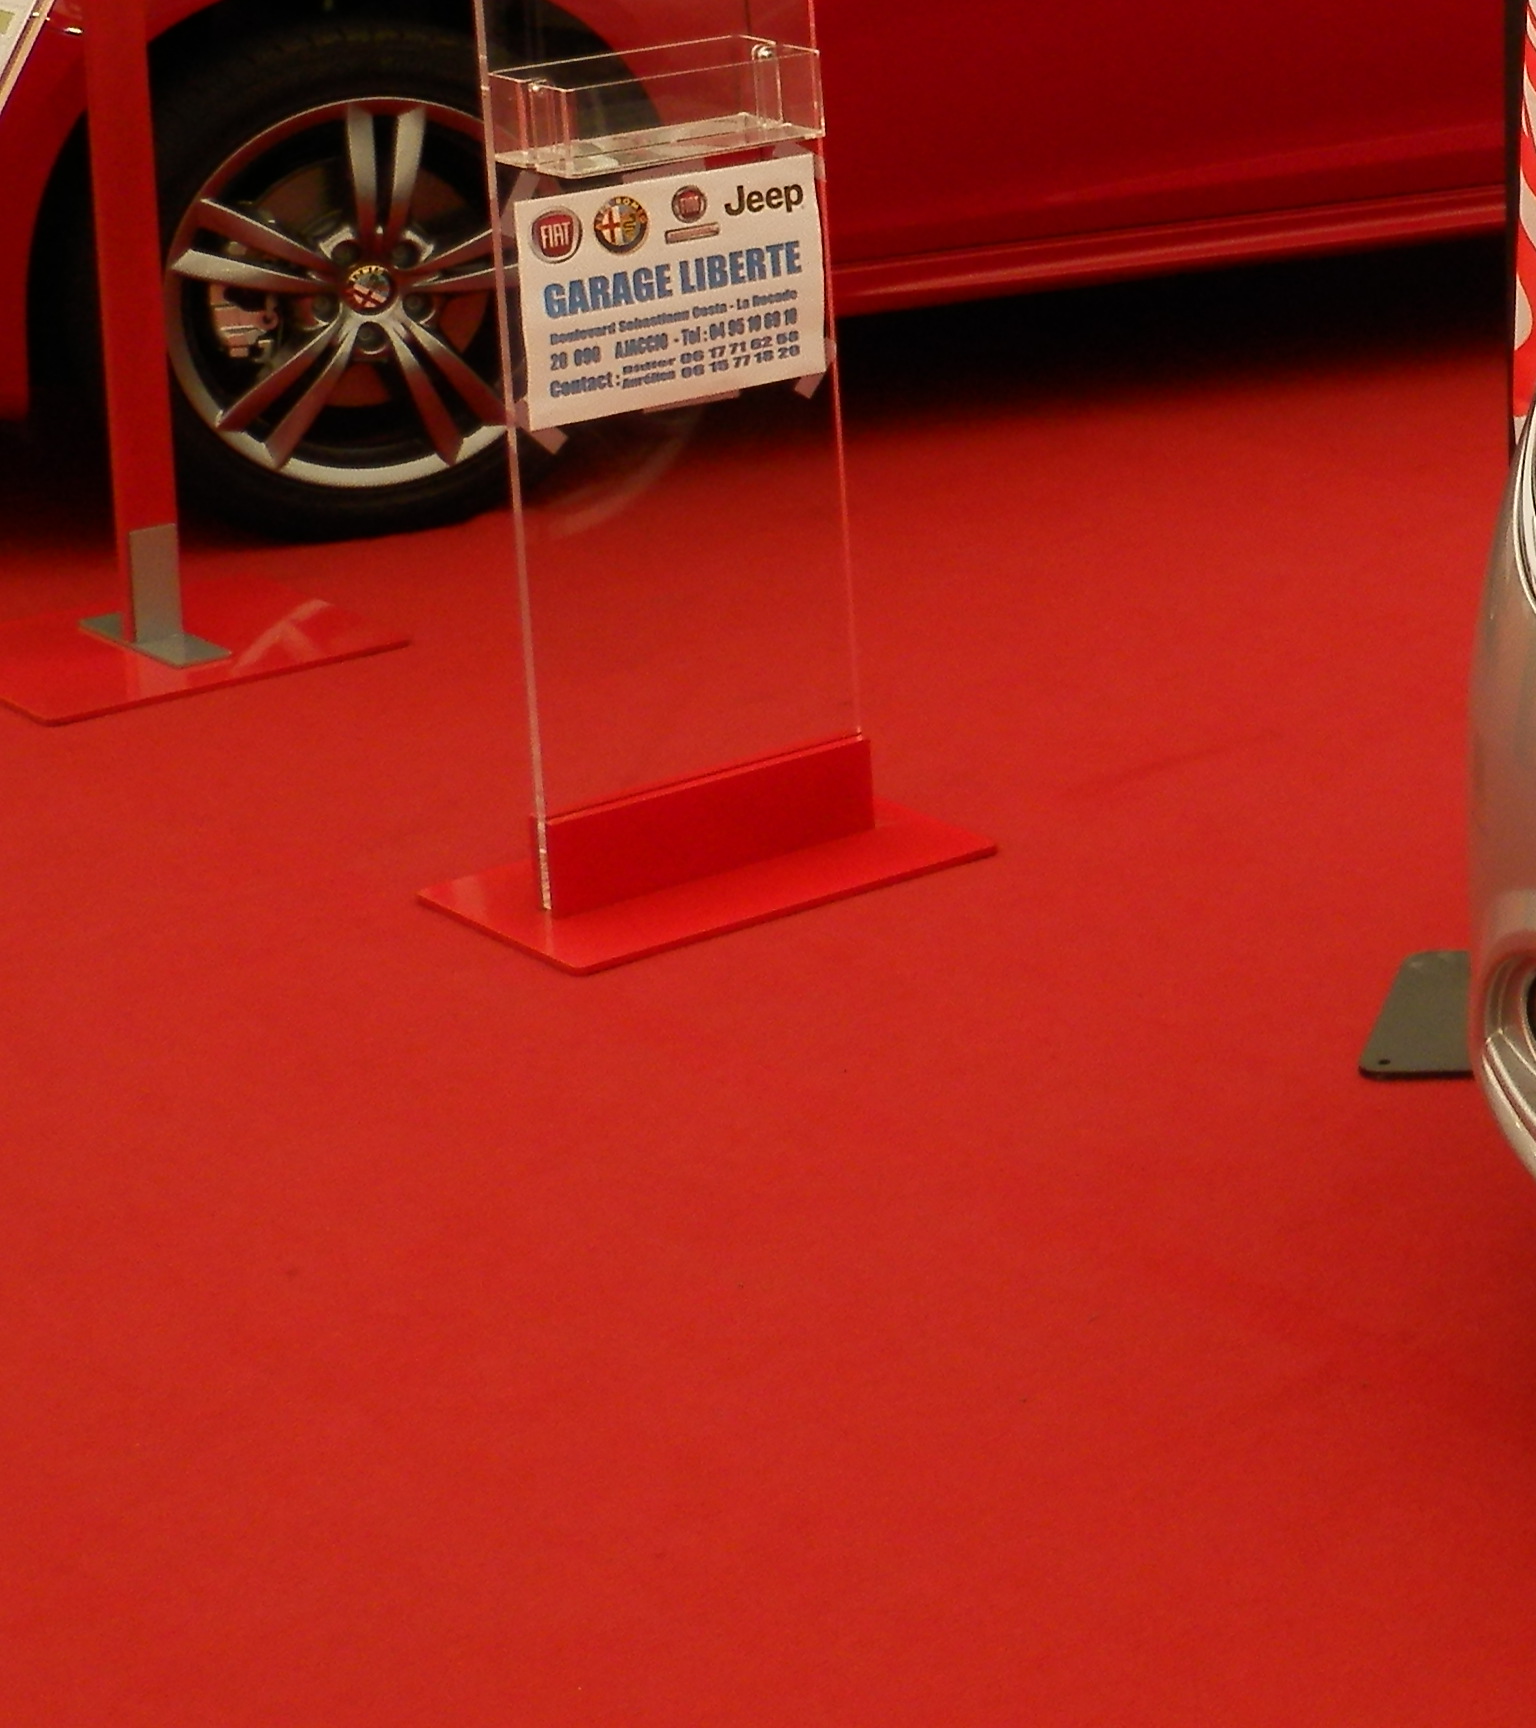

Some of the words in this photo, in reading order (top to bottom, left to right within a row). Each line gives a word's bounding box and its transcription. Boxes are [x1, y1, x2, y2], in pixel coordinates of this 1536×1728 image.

[724, 183, 804, 217] Jeep
[540, 221, 572, 249] FIAT
[543, 264, 673, 319] GARAGE
[679, 240, 803, 295] LIBERTE
